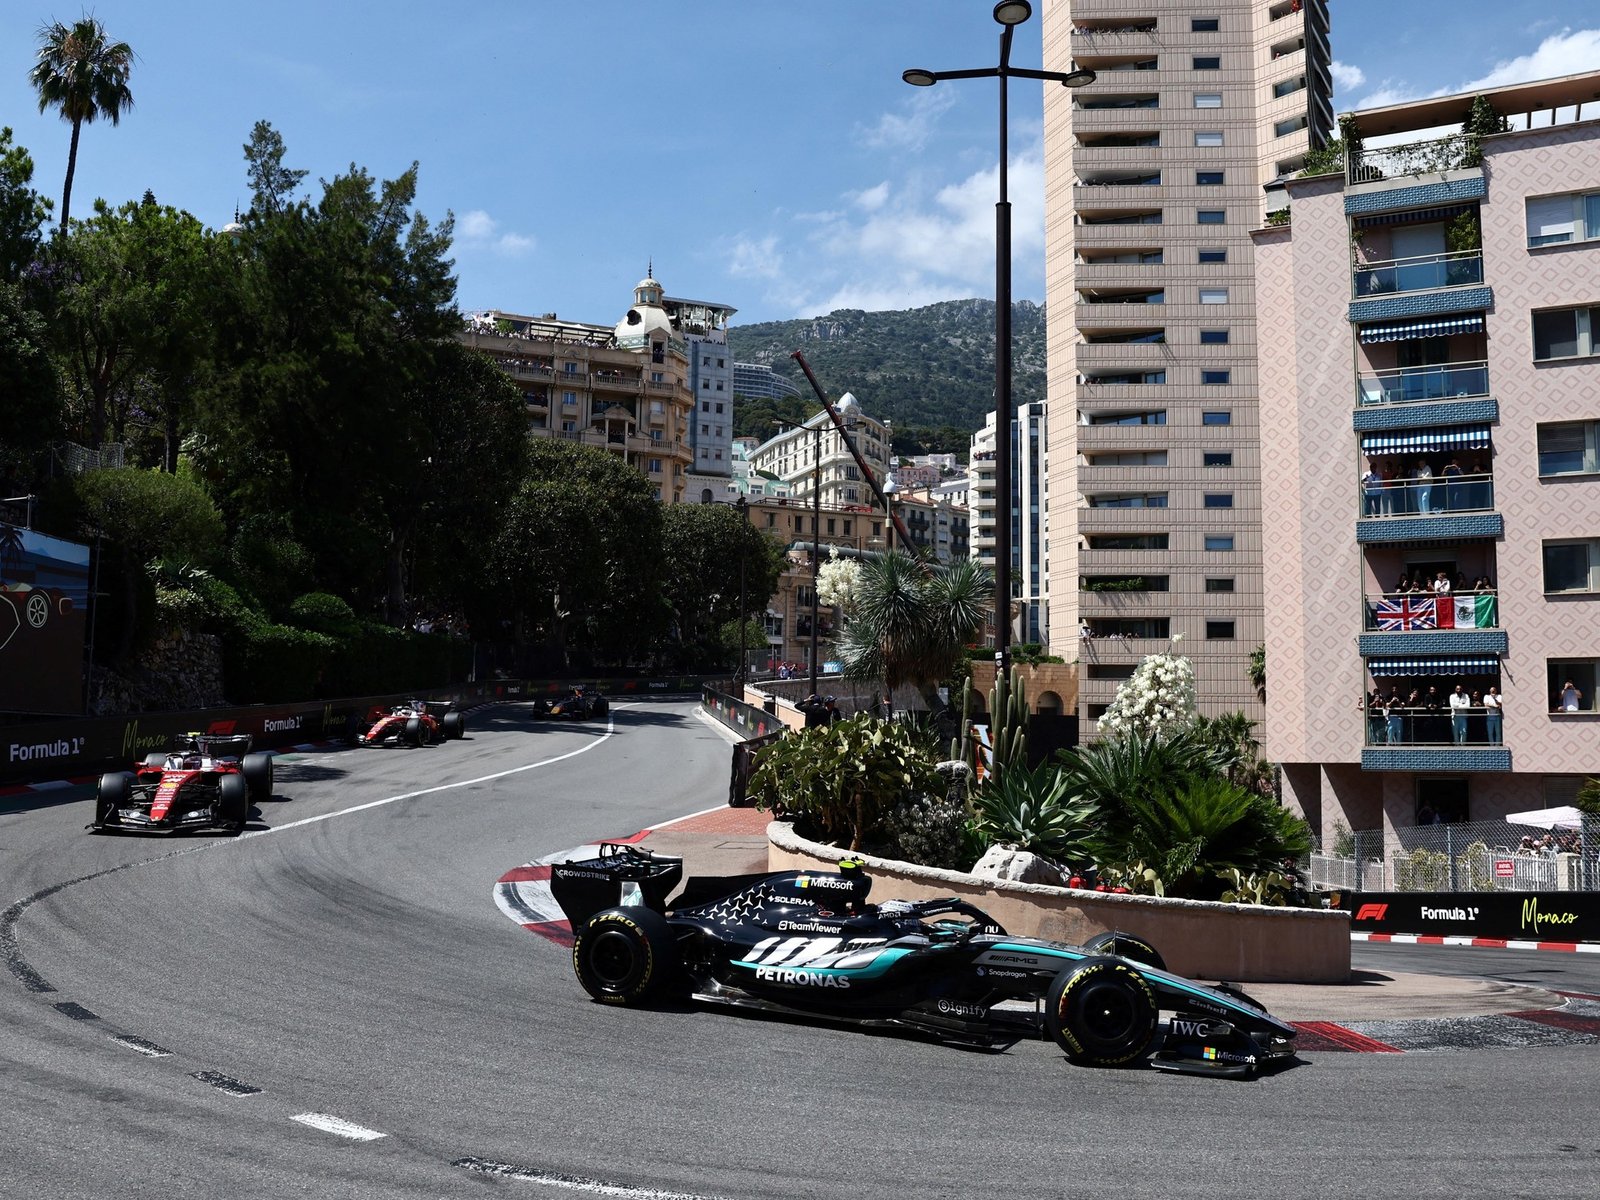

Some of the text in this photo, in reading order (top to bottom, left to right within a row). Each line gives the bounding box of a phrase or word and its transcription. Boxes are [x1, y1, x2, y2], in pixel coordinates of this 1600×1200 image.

[263, 717, 295, 733] Formula
[122, 720, 168, 758] Monaco
[10, 739, 70, 762] Formula
[558, 868, 611, 881] CROWDSTRIKE
[810, 878, 854, 891] Microsoft
[774, 895, 809, 906] SOLERA
[1421, 906, 1467, 920] Formula
[1521, 896, 1578, 934] Monaco
[598, 914, 636, 928] ZERO
[788, 920, 842, 934] TeamViewer
[1005, 957, 1039, 965] AMG
[756, 966, 851, 989] PETRONAS
[988, 968, 1027, 979] Snapdragon
[1127, 971, 1157, 1010] ZERO
[1172, 1020, 1209, 1038] IWC
[1217, 1050, 1256, 1064] Microsoft
